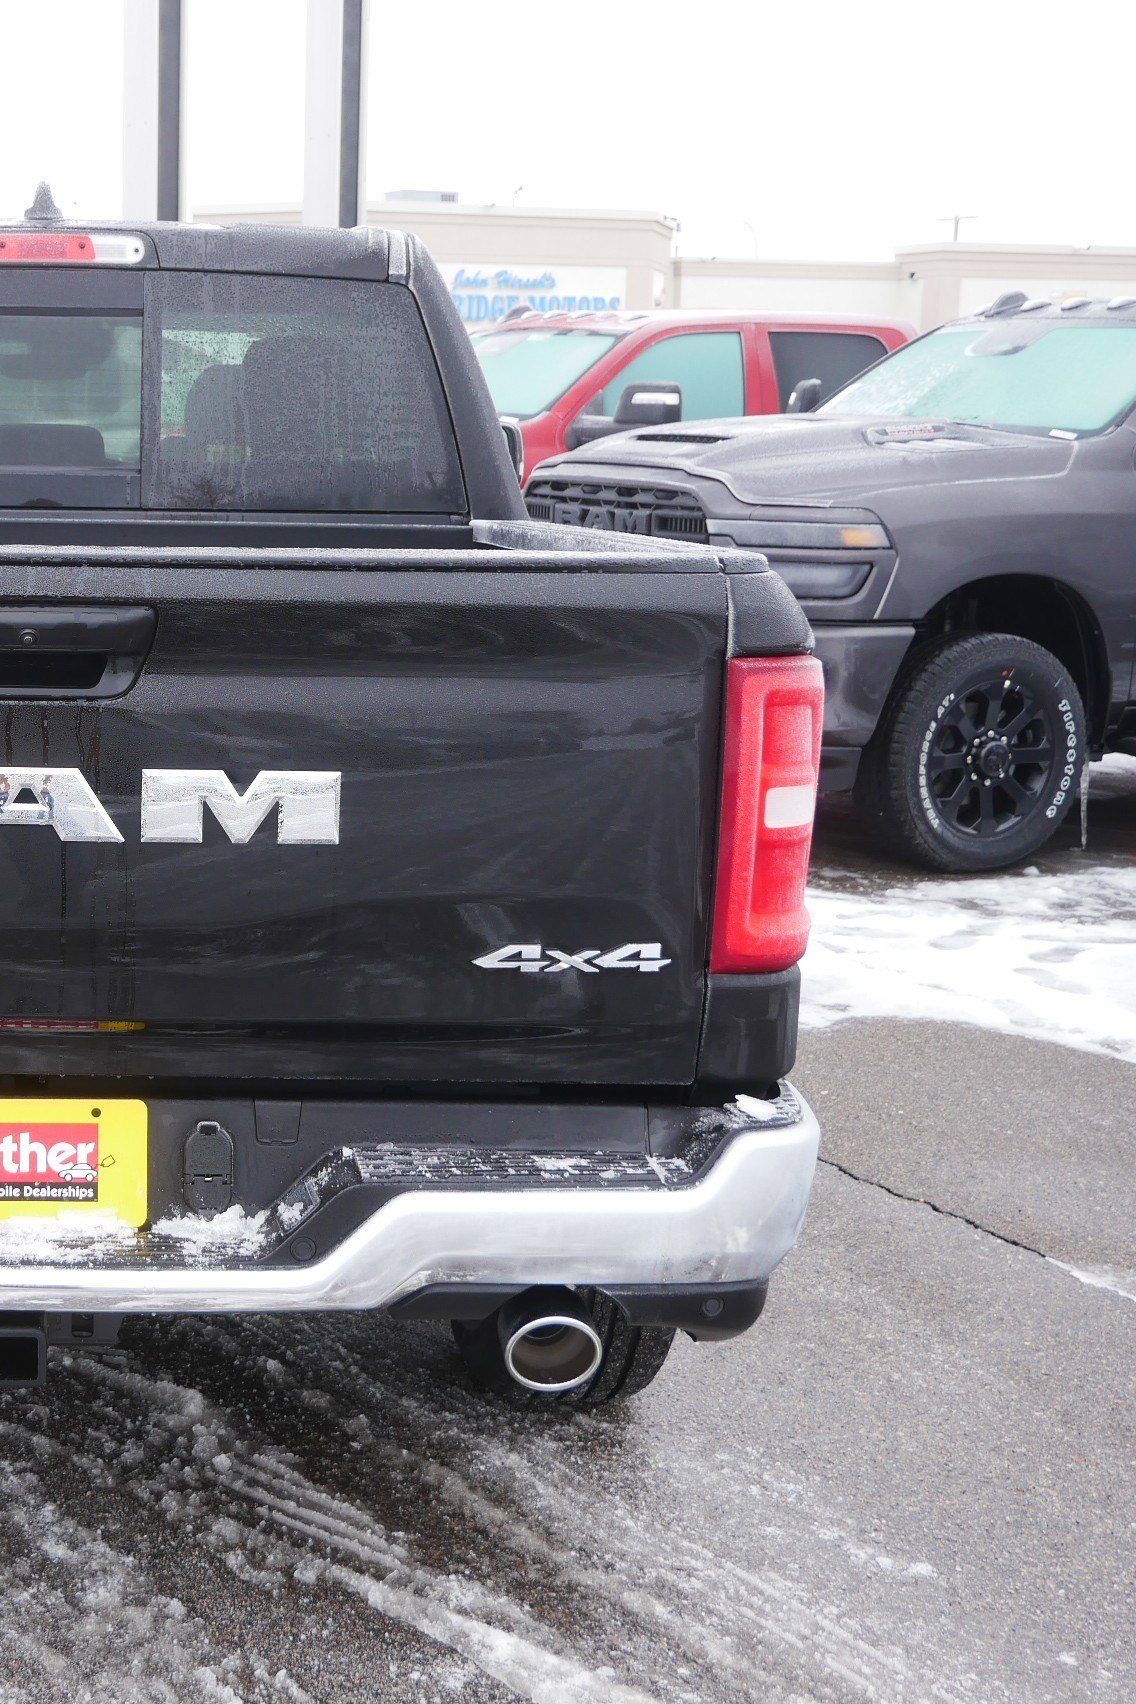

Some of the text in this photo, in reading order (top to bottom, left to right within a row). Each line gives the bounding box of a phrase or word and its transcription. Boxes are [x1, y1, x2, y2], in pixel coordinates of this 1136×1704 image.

[452, 269, 489, 290] John
[555, 503, 654, 535] RAM
[471, 942, 672, 972] 4x4
[23, 1185, 94, 1200] Dealerships
